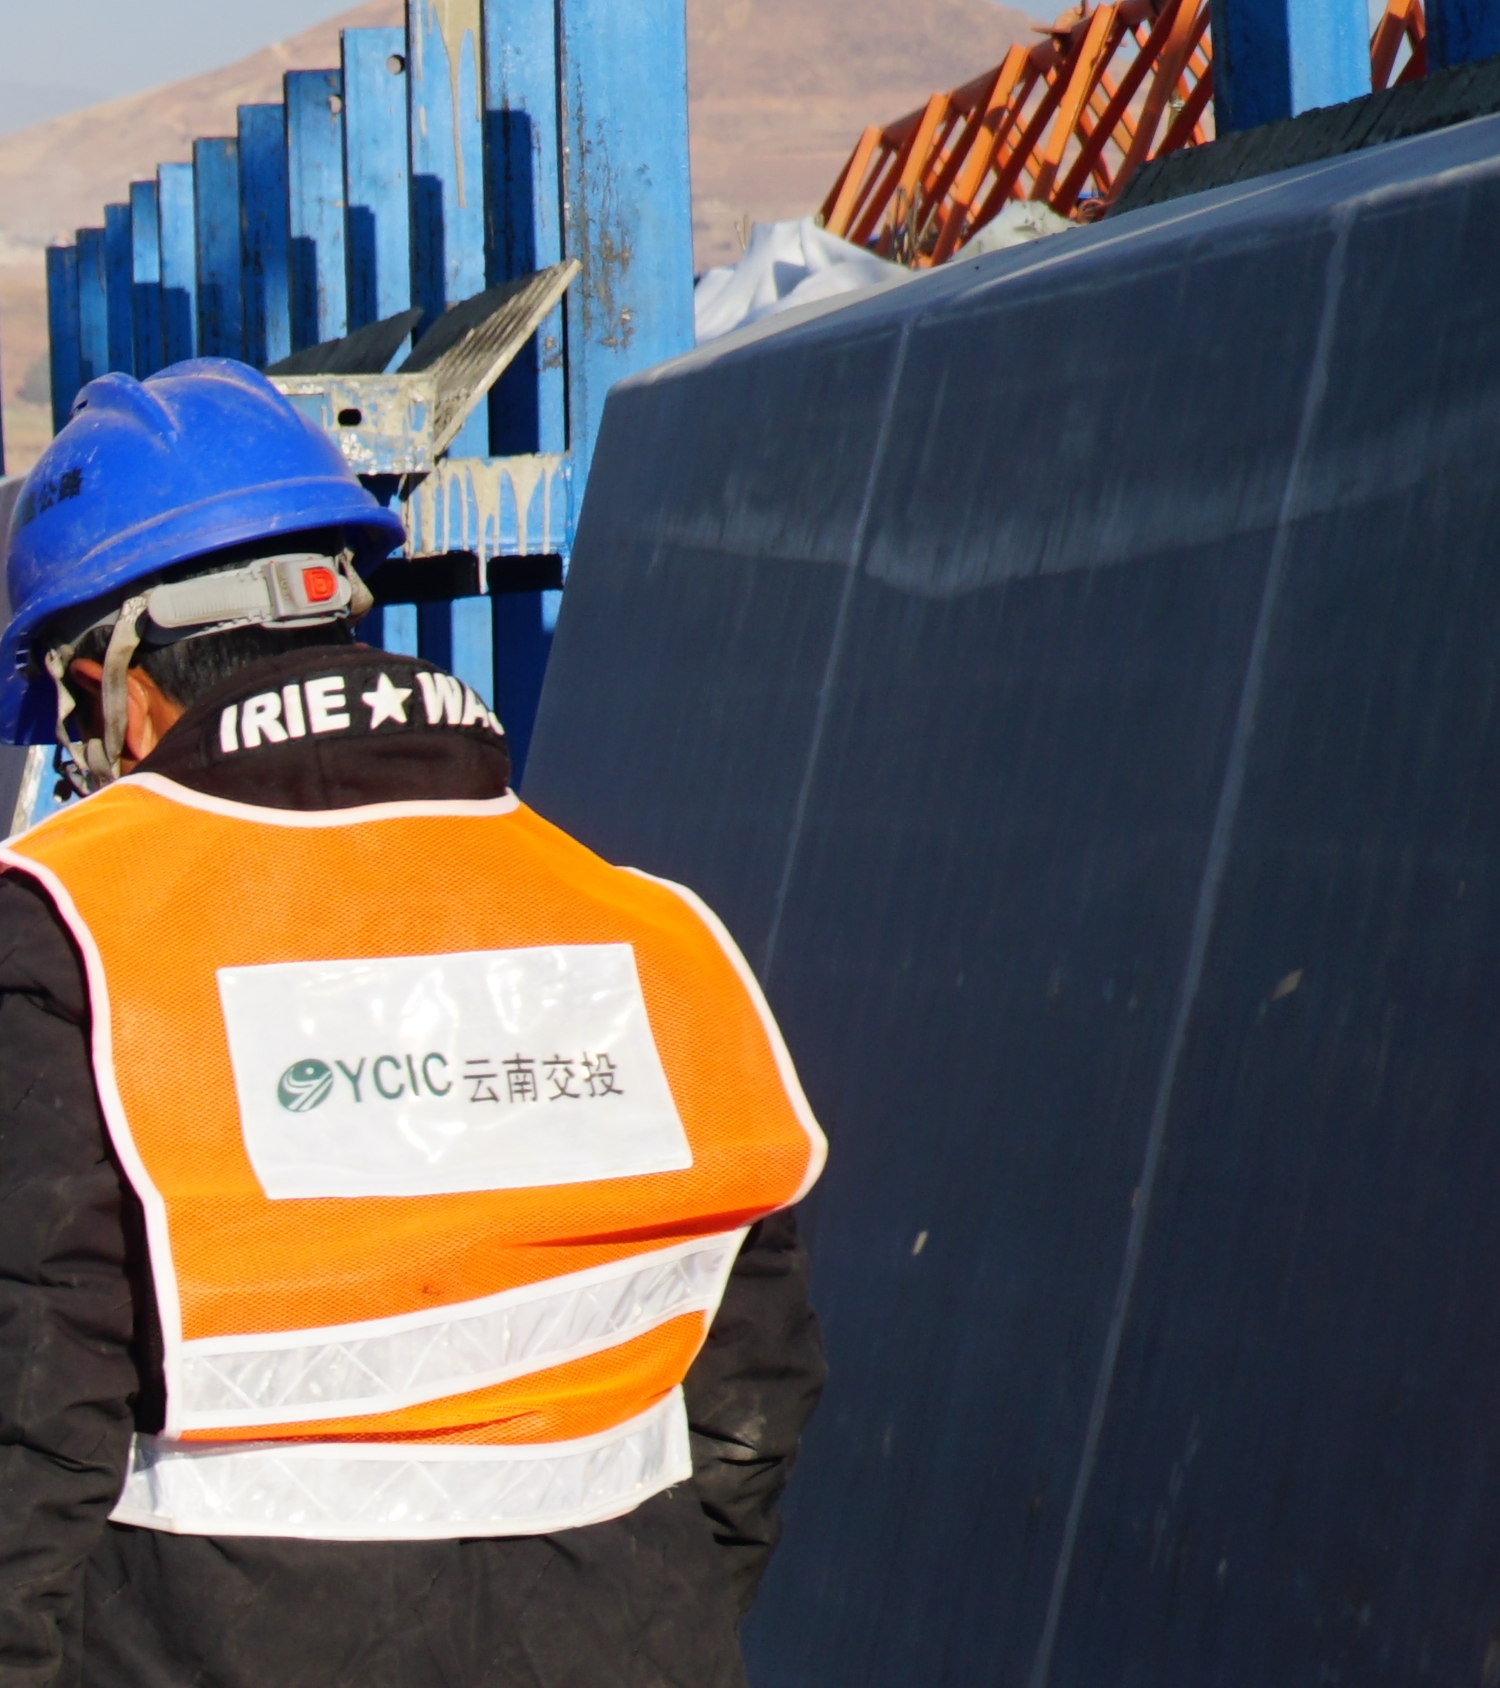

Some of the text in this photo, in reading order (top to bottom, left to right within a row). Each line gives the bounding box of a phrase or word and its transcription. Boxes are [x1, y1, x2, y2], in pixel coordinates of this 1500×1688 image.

[219, 671, 505, 753] IRIE WA
[334, 1051, 625, 1104] YCIC 云南交投
